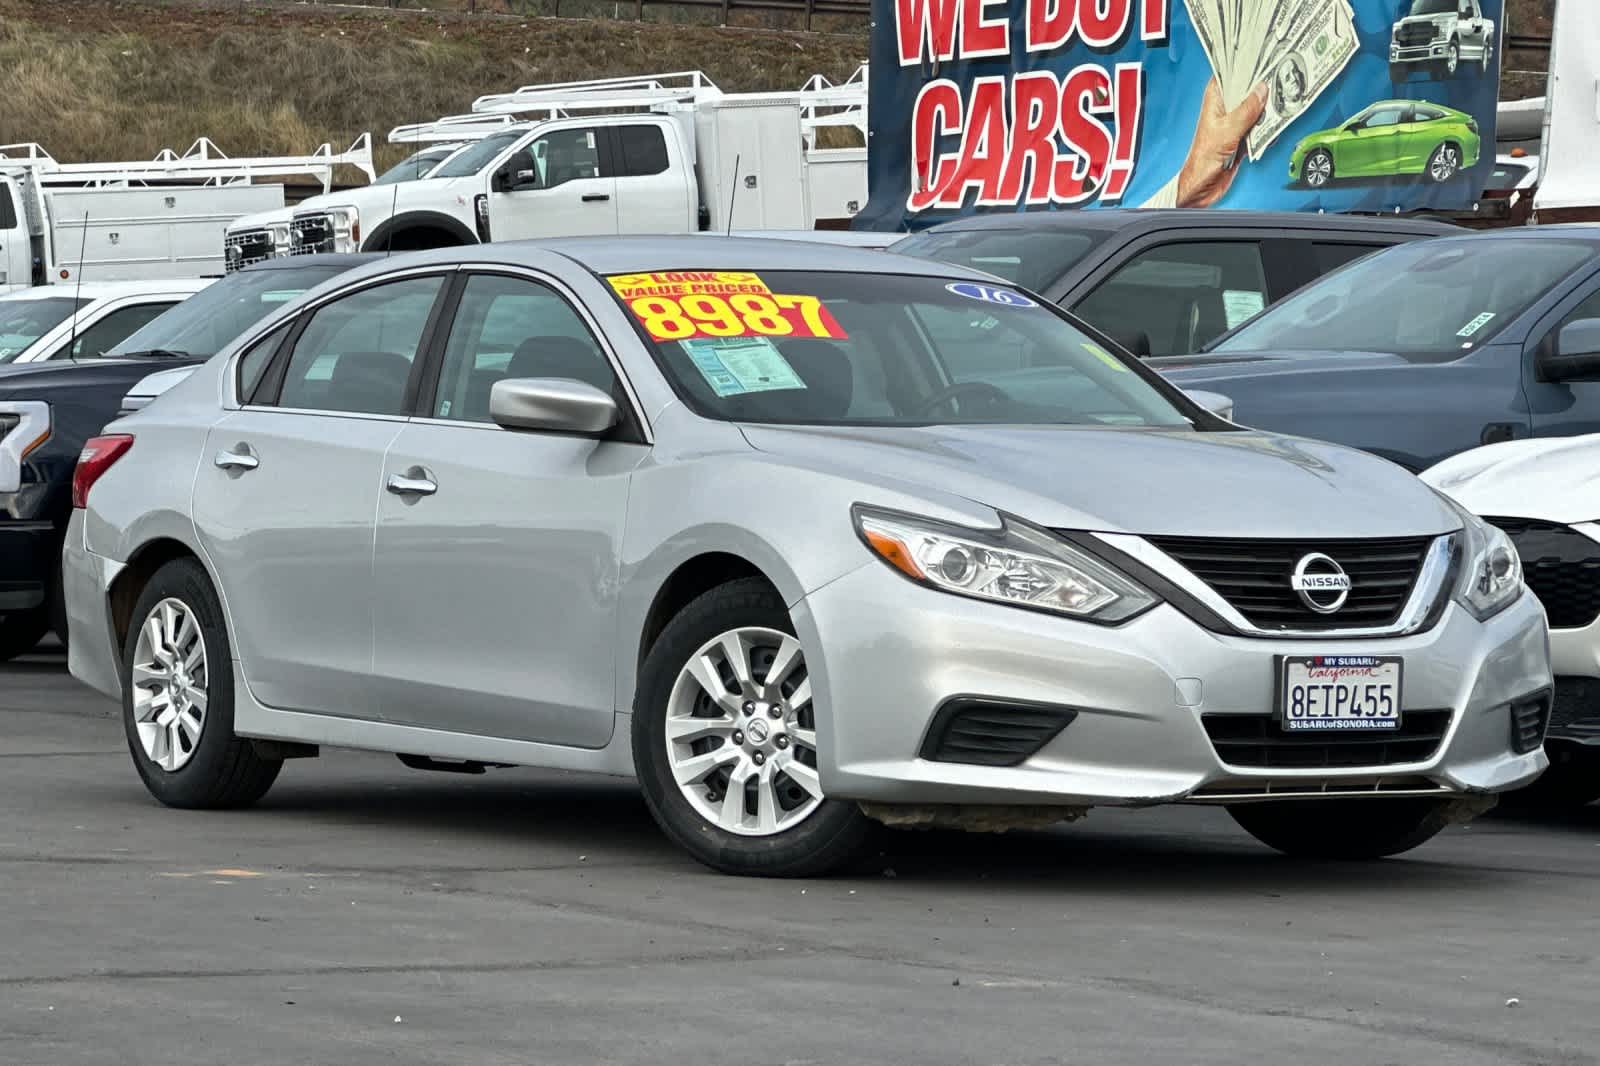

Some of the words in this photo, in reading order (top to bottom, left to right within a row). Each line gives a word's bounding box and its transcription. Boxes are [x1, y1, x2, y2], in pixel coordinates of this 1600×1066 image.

[906, 61, 1142, 212] CARS!
[650, 271, 721, 283] LOOK
[620, 284, 686, 298] VALUE
[691, 283, 764, 294] PRICED
[631, 293, 832, 338] 8987
[1301, 577, 1348, 587] NISSAN
[1324, 657, 1336, 666] MY
[1338, 657, 1375, 666] SUBARU
[1306, 666, 1380, 682] California
[1291, 685, 1393, 718] 8EIP455
